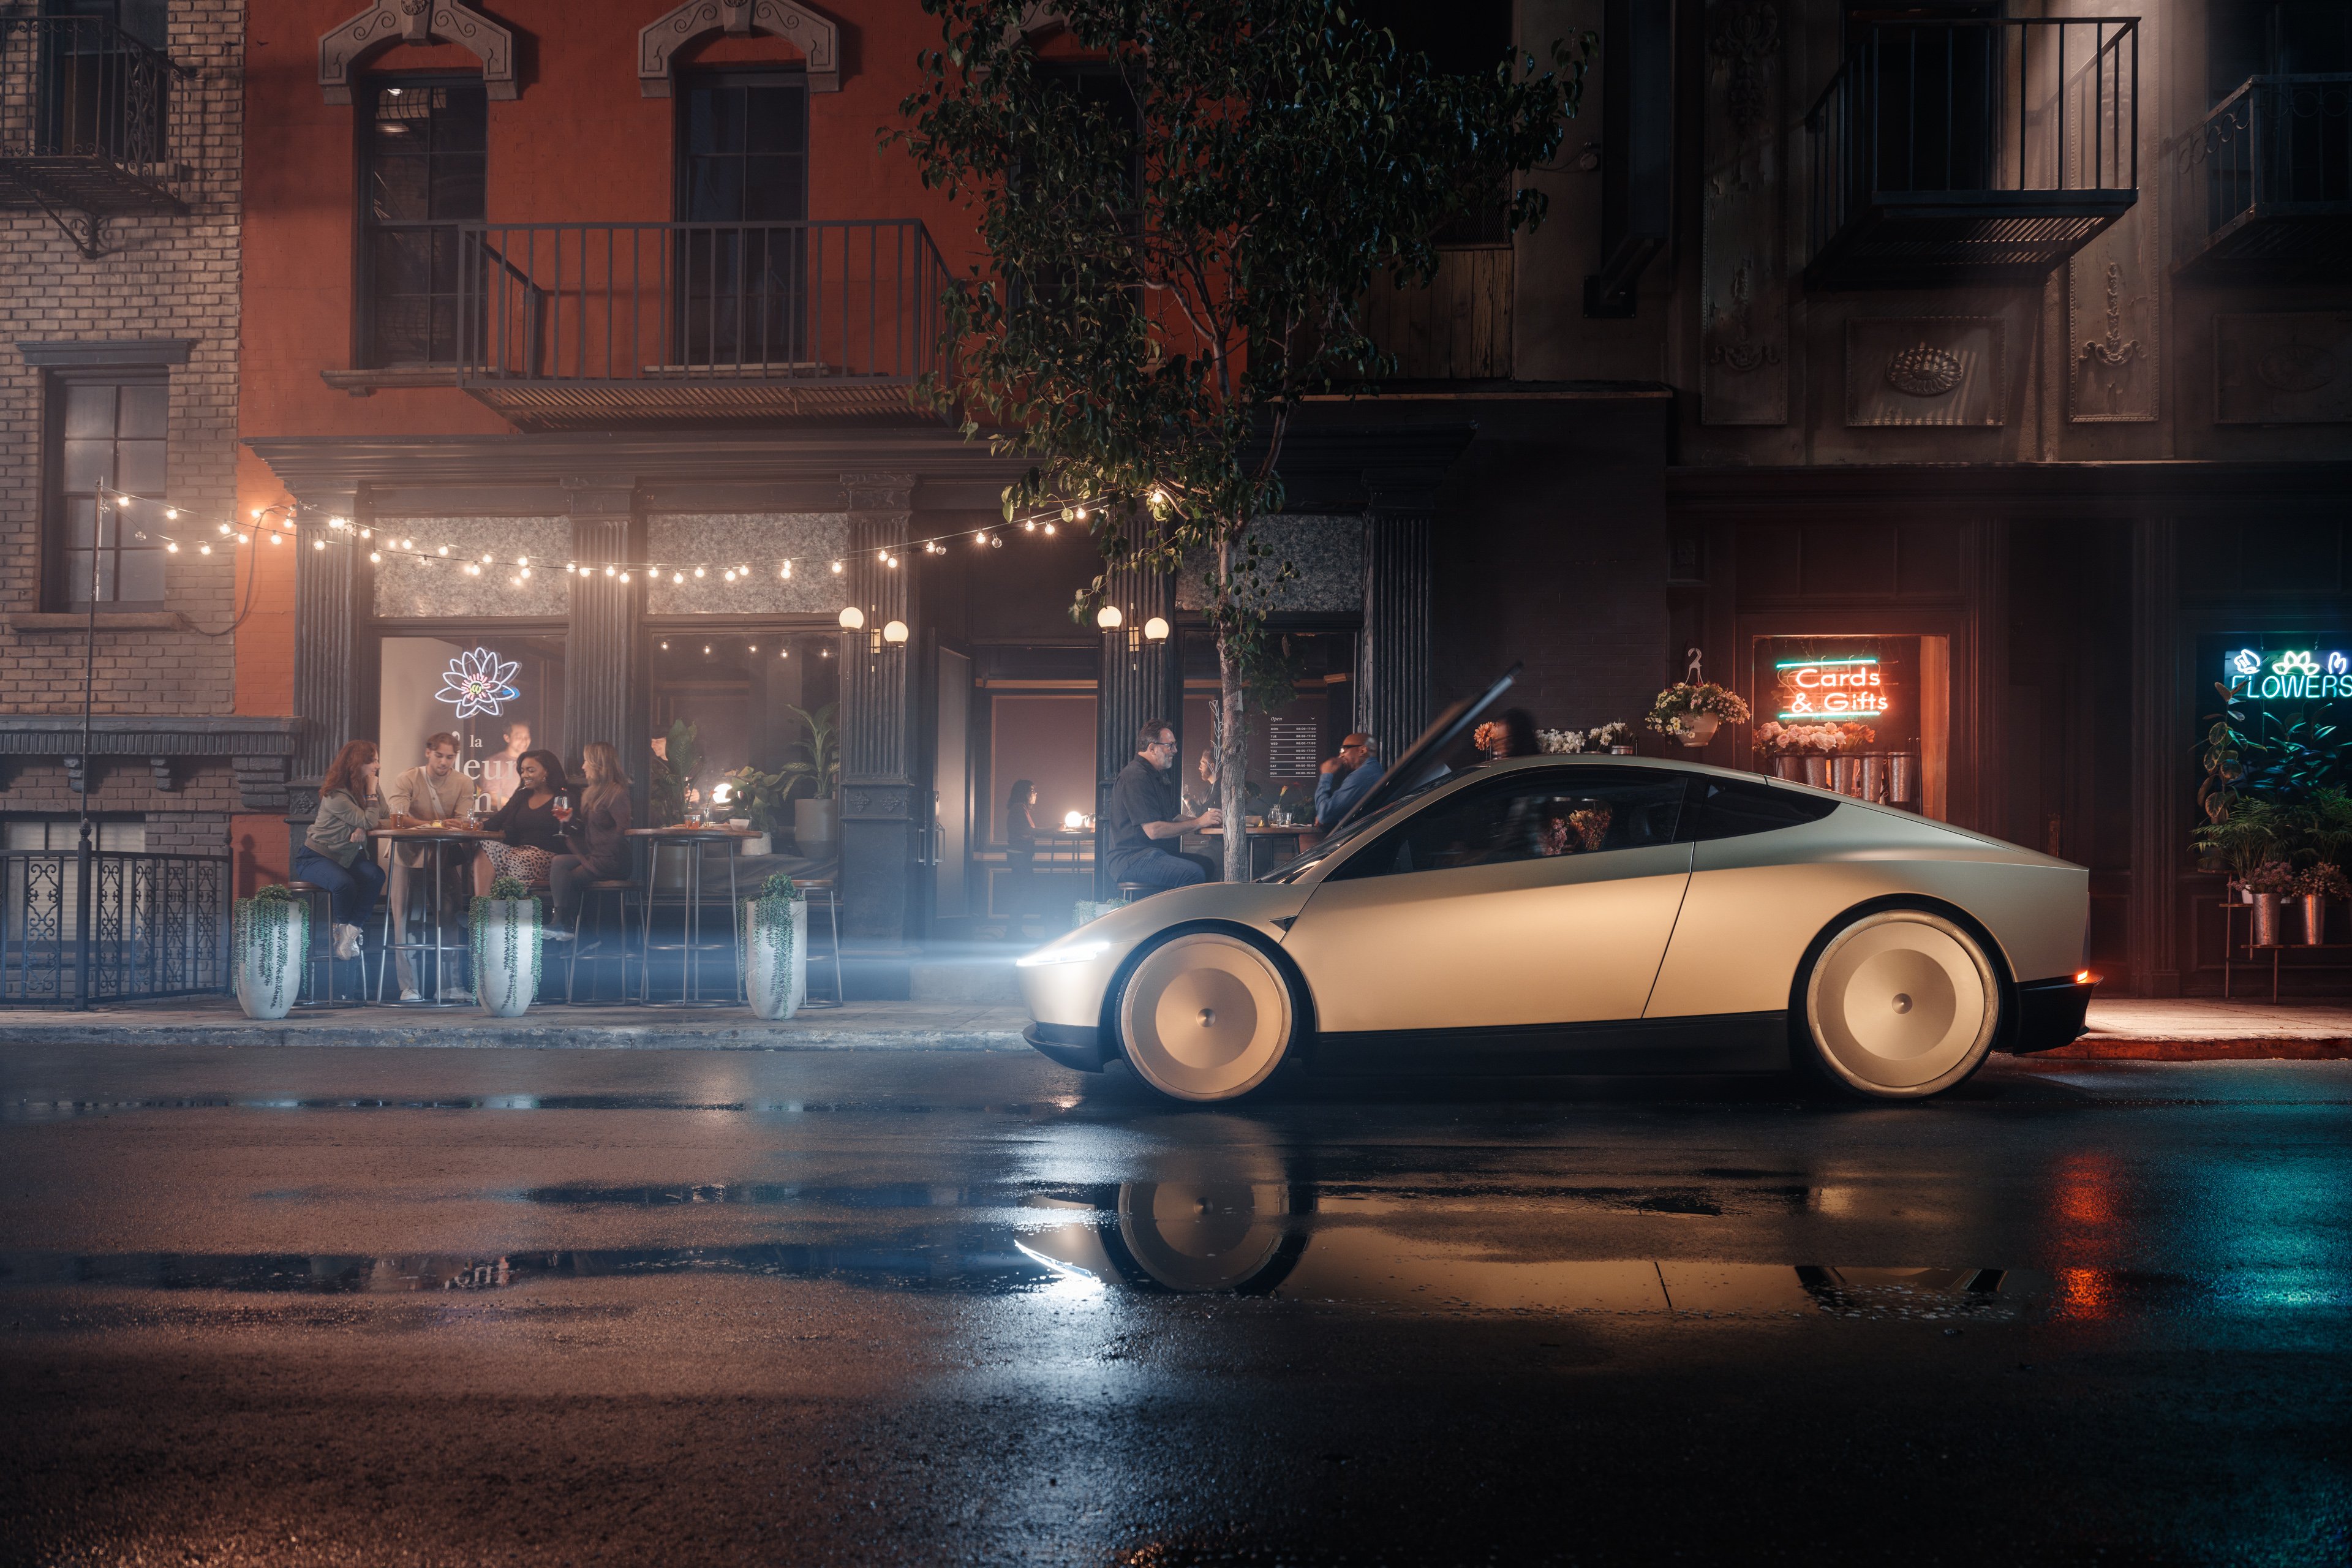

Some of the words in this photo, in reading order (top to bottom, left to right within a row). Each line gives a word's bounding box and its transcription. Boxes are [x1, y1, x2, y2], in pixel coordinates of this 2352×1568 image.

[1795, 667, 1881, 688] Cards
[2231, 675, 2352, 698] FLOWERS
[1791, 692, 1814, 714] &
[1823, 691, 1889, 712] Gifts
[469, 734, 483, 747] la
